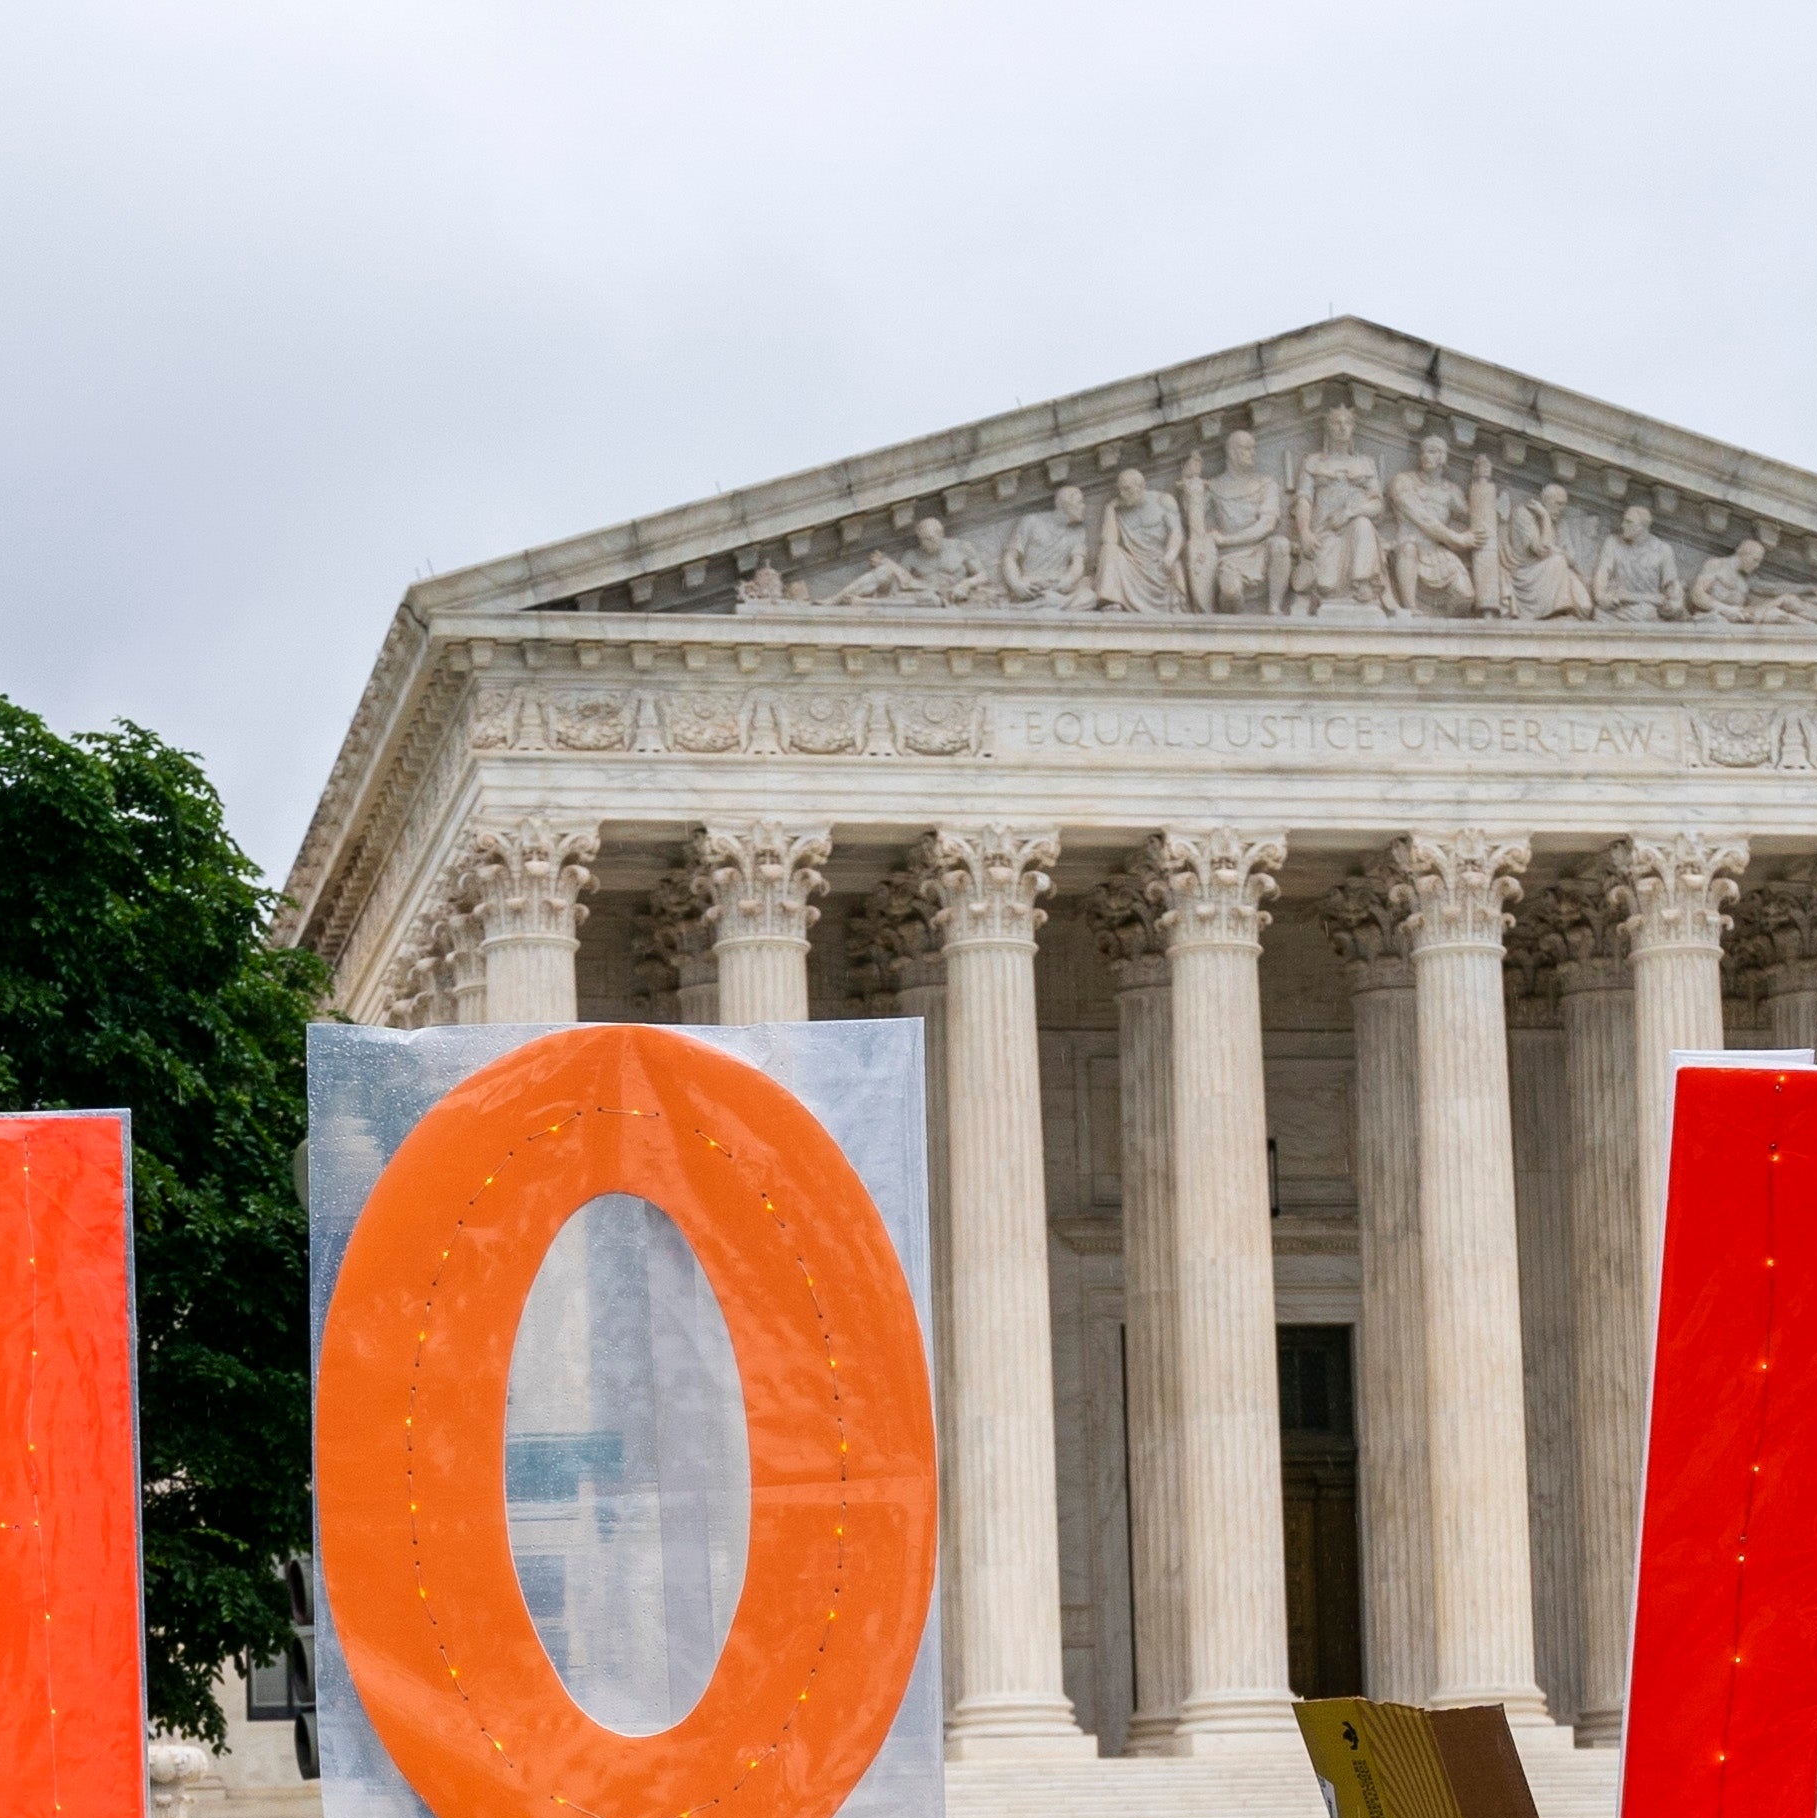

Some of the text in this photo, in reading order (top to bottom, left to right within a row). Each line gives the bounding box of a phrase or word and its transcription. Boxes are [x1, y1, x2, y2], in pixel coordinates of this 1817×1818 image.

[1024, 710, 1656, 755] EQUAL JUSTICE UNDER LAW
